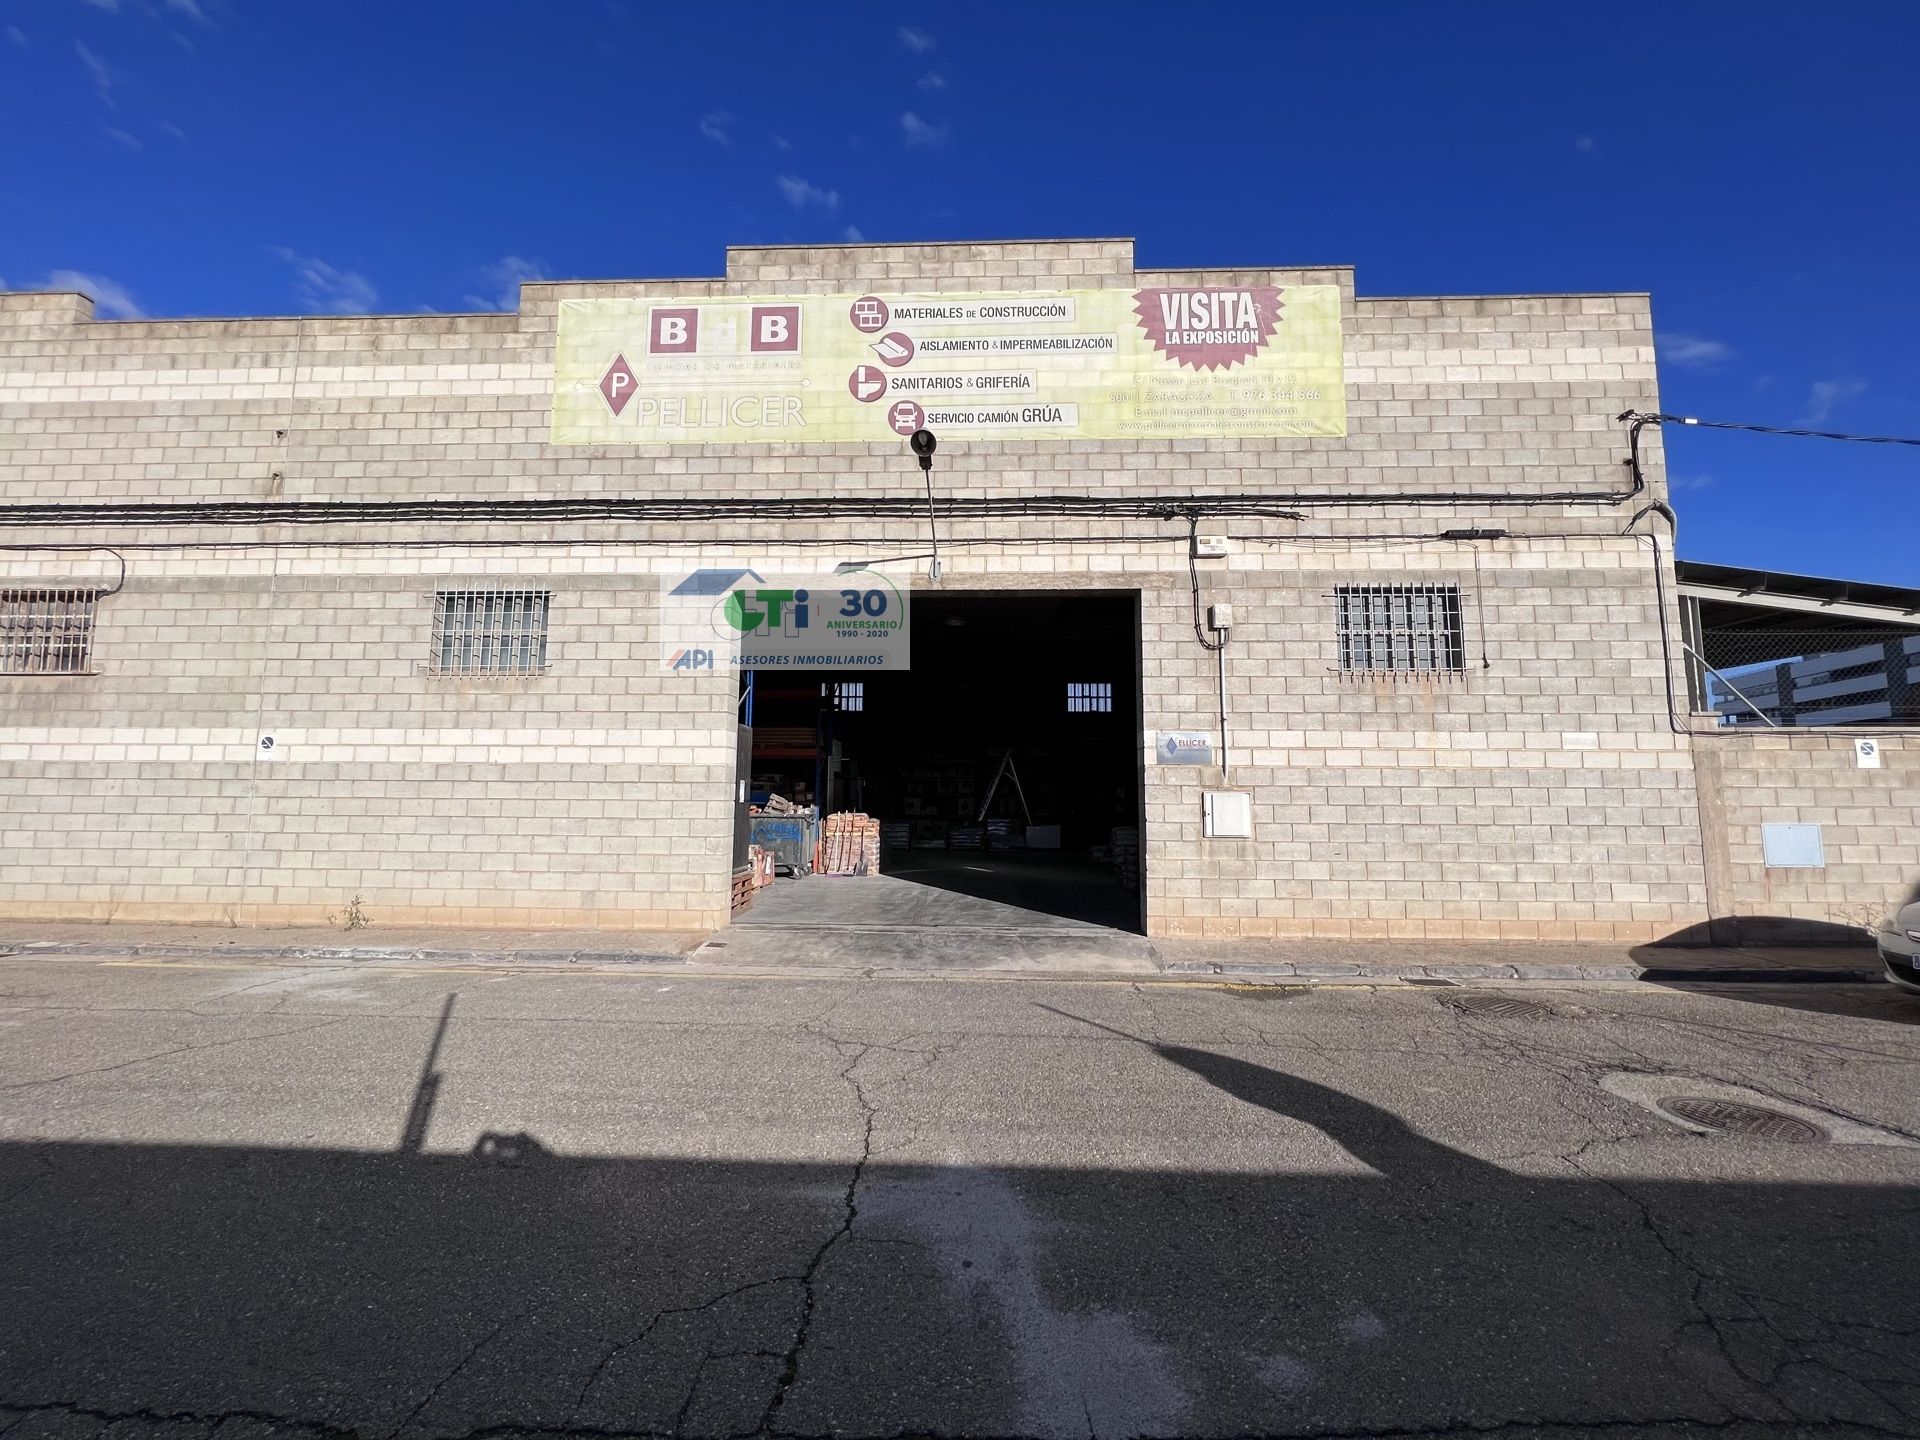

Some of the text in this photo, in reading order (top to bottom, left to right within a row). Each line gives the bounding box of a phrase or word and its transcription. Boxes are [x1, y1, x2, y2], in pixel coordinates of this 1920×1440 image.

[894, 303, 1066, 319] MATERIALES DE CONSTRUCCIÓN
[1159, 292, 1258, 330] VISITA
[659, 317, 688, 345] B
[760, 315, 789, 343] B
[1165, 329, 1259, 345] LA EXPOSICIÓN
[919, 335, 1113, 351] AISLAMIENTO & IMPERMEABILIZACIÓN
[610, 372, 630, 398] P
[891, 373, 1030, 390] SANITARIOS & GRIFERÍA
[1144, 391, 1214, 402] ZARAGOZA
[1241, 389, 1266, 401] 976
[1271, 388, 1294, 401] 344
[1297, 387, 1323, 401] 566
[636, 395, 807, 428] PELLICER
[927, 407, 1063, 424] SERVICIO CAMIÓN GRÚA
